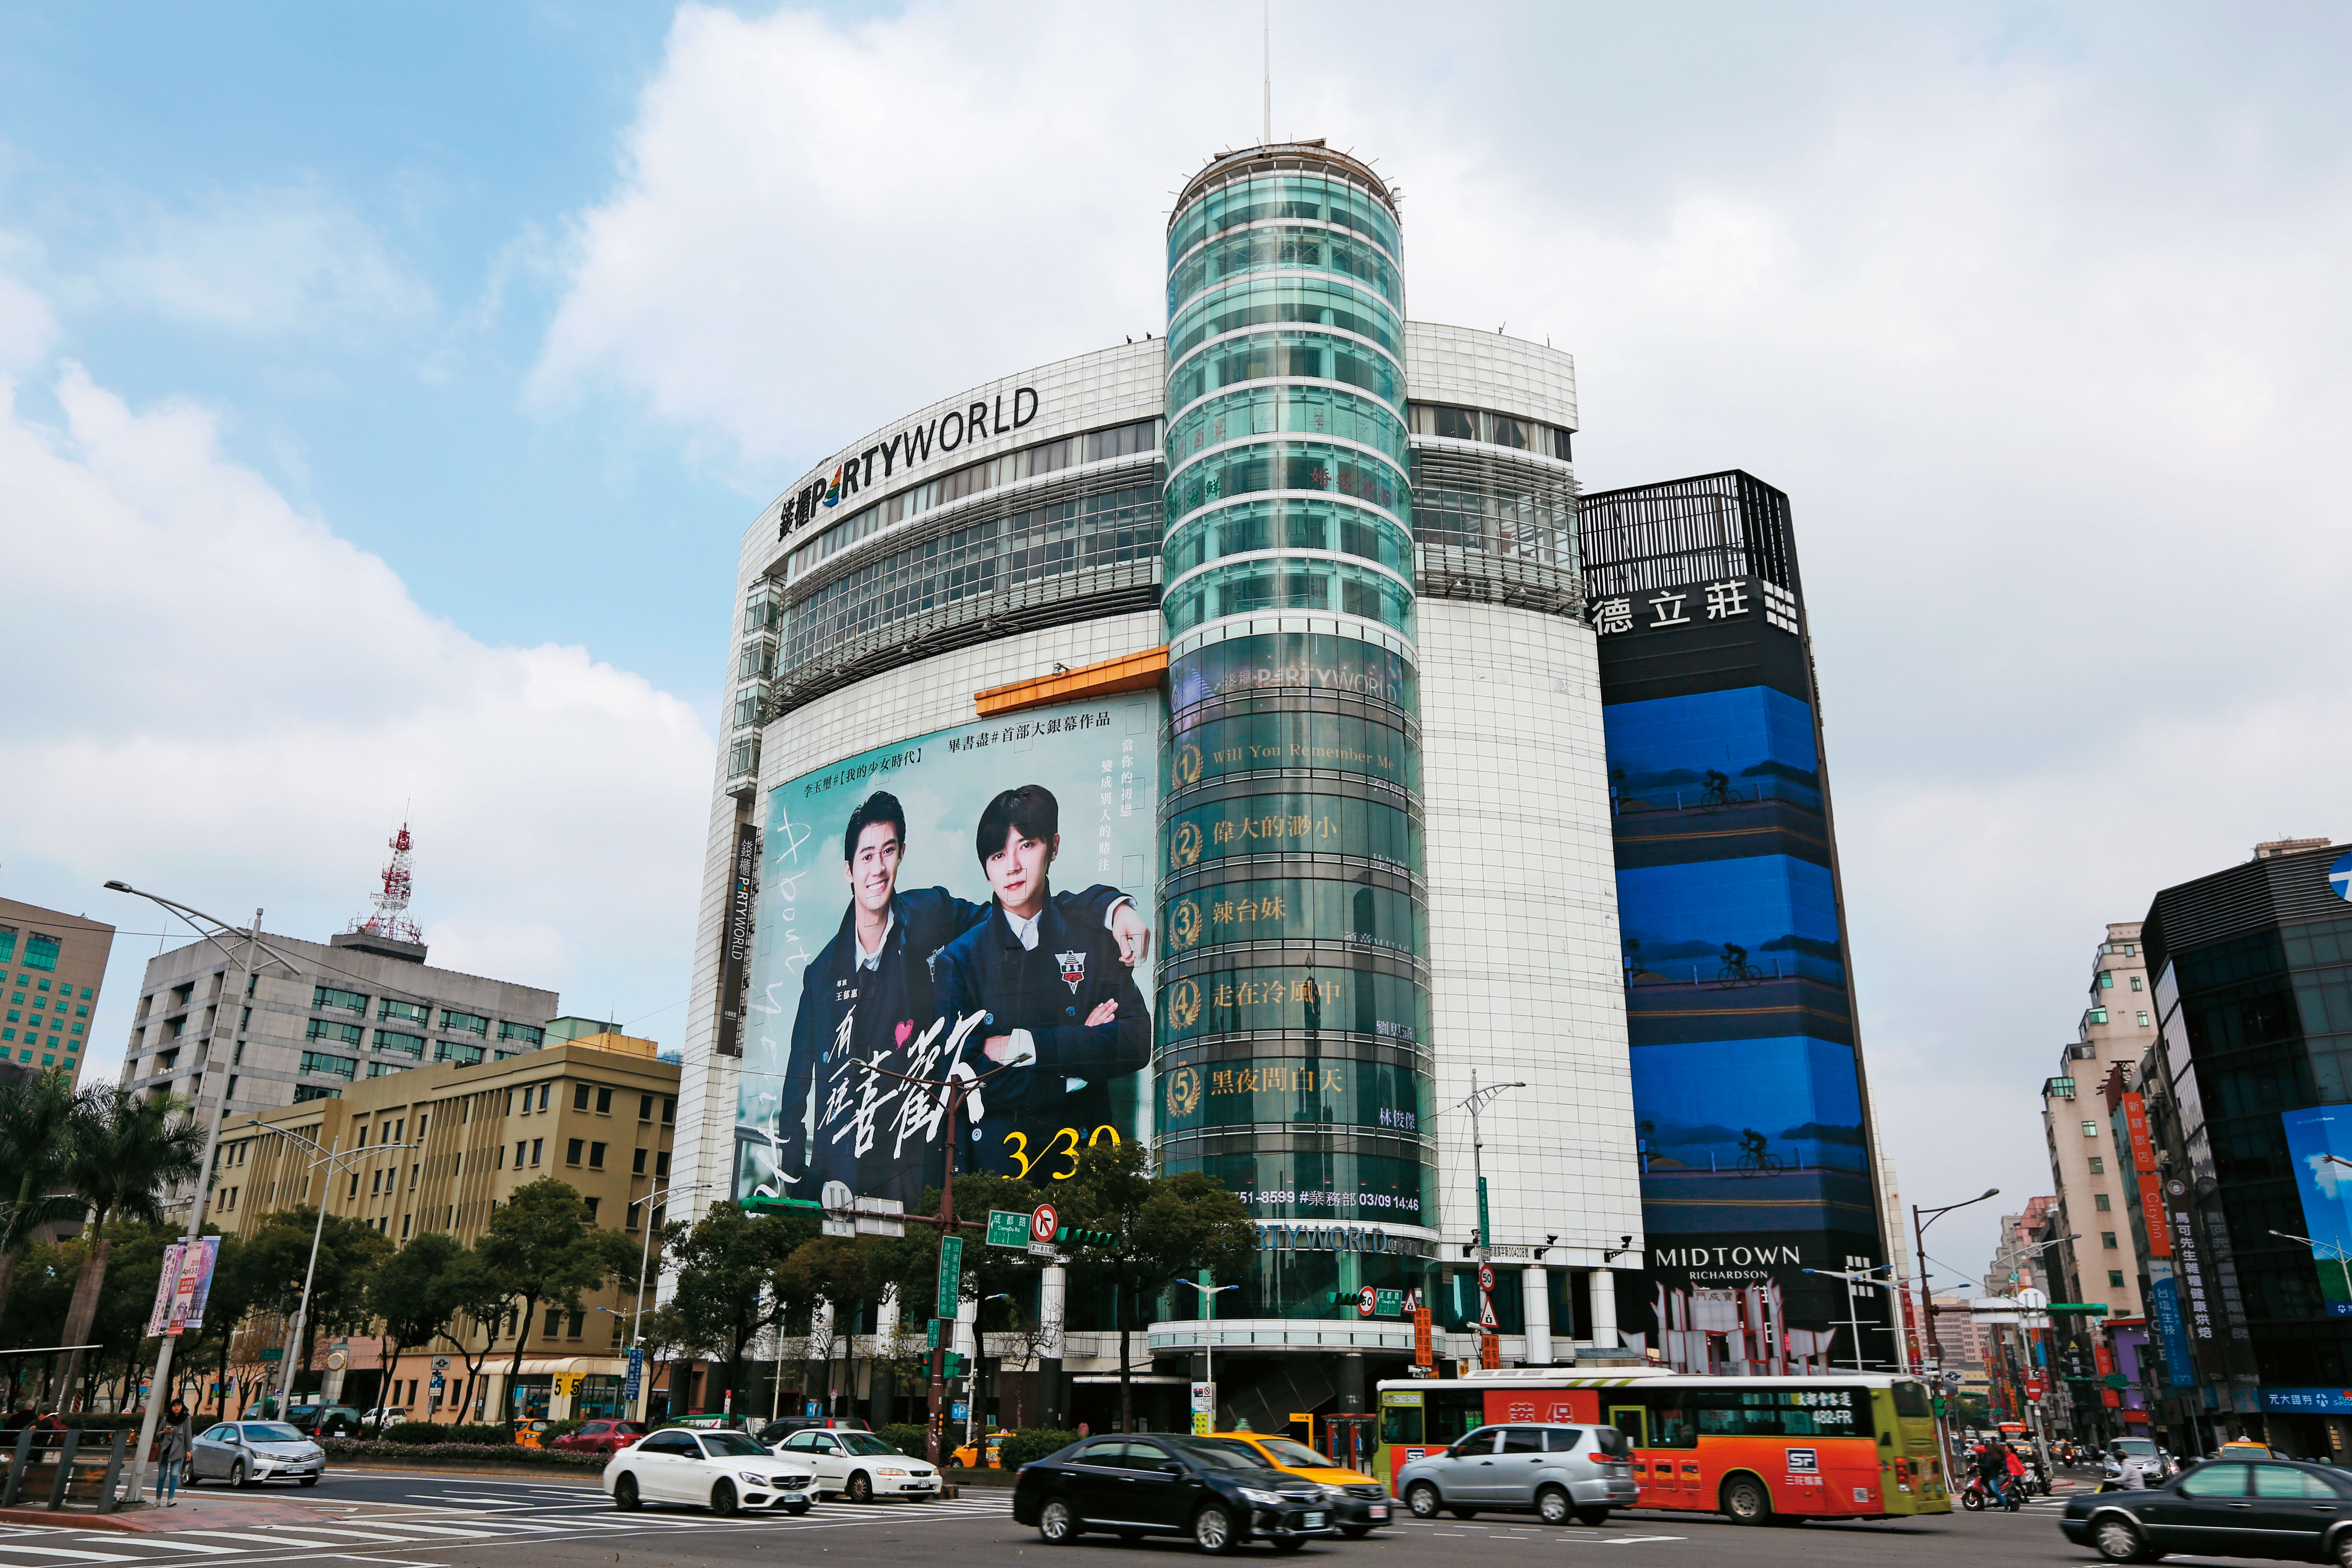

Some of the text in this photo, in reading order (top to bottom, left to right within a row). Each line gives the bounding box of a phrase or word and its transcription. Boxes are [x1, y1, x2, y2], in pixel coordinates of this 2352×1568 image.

[1592, 580, 1749, 635] 德立莊
[948, 711, 1110, 753] 畢書盡#首部大銀幕作品
[1214, 744, 1394, 771] Will You Remember Me
[1120, 739, 1133, 817] 當你的初戀
[1098, 760, 1113, 872] 變成別人的賭注
[1213, 815, 1337, 845] 偉大的渺小
[739, 839, 752, 876] 錢櫃
[1212, 896, 1286, 925] 辣台妹
[1212, 980, 1340, 1009] 走在冷風中
[1211, 1067, 1343, 1096] 黑夜問白天
[1379, 1107, 1415, 1130] 林俊傑
[2128, 1101, 2149, 1163] 新驛旅店
[1359, 1193, 1391, 1207] 03/09
[1393, 1197, 1419, 1211] 14:46
[993, 1214, 1026, 1227] 成都路
[1655, 1246, 1800, 1266] MIDTOWN
[949, 1243, 960, 1314] 往臺北車站方向
[1483, 1273, 1492, 1283] 50
[1690, 1271, 1768, 1279] RICHARDSON
[2269, 1394, 2312, 1405] 元大證券
[1812, 1410, 1853, 1423] 482-FR
